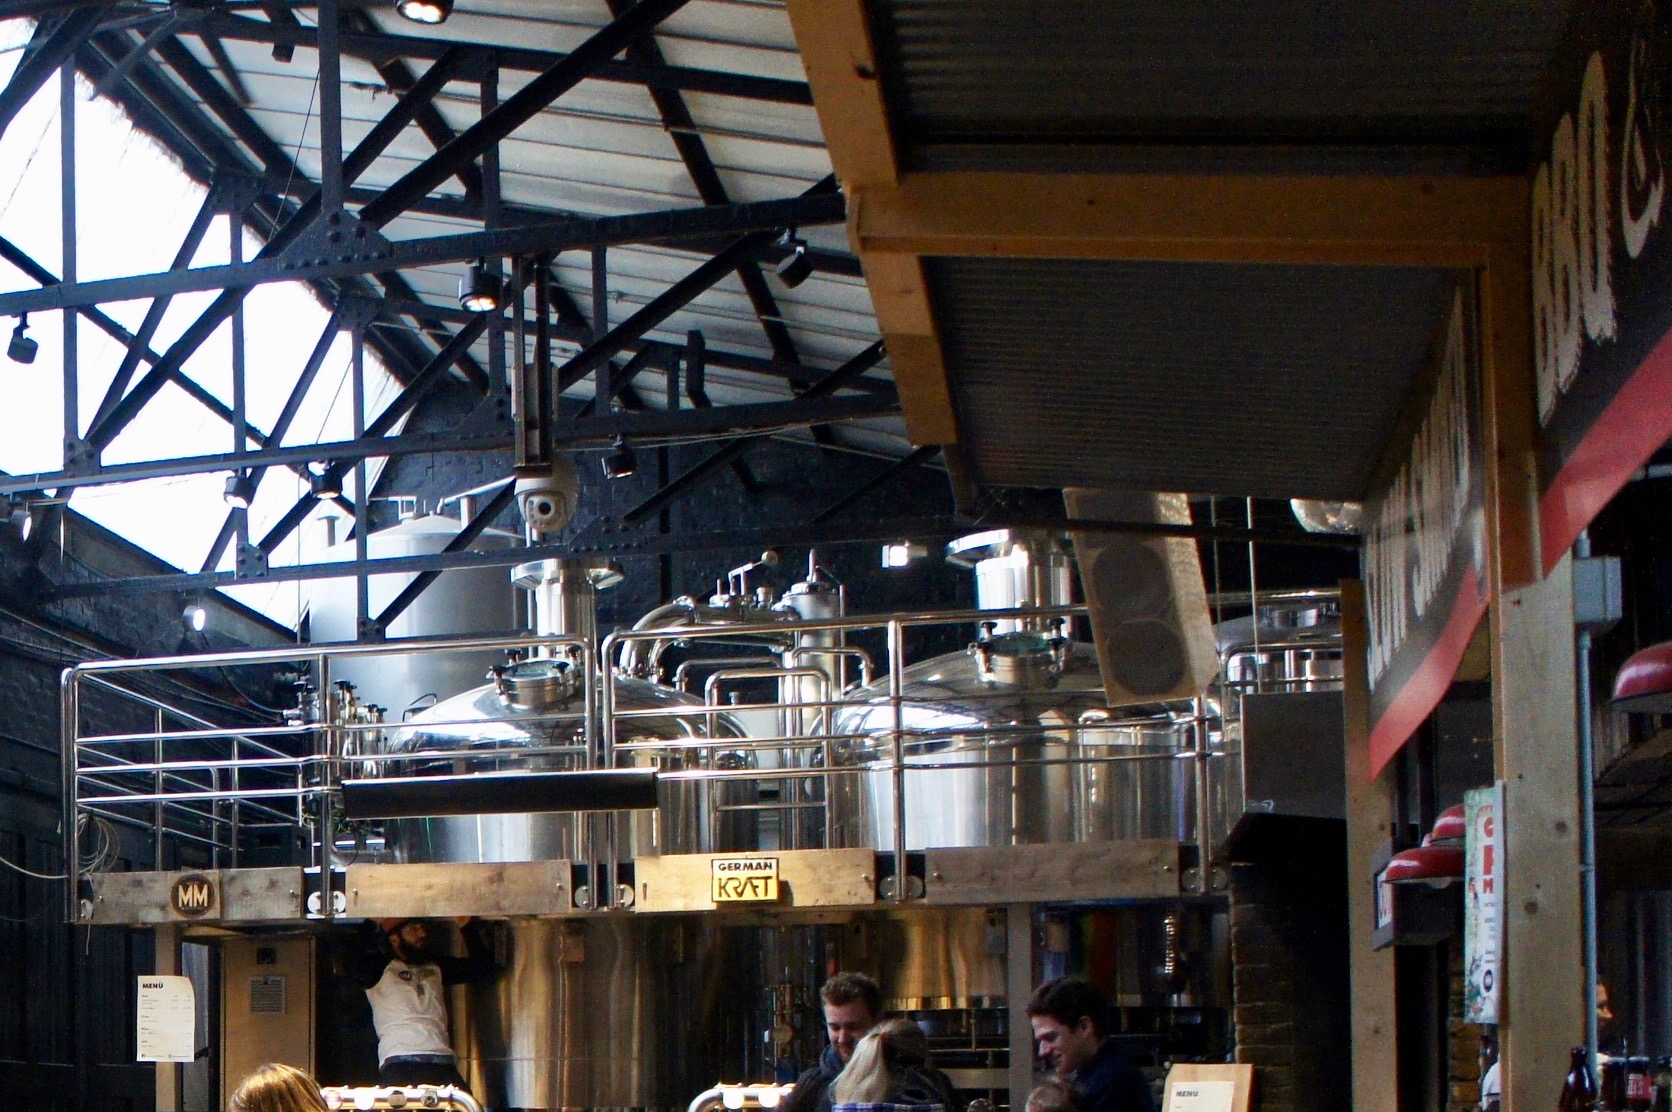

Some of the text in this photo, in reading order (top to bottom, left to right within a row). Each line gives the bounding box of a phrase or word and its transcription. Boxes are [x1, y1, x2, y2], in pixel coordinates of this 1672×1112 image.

[718, 862, 772, 871] GERMAN
[178, 884, 208, 907] MM
[718, 876, 773, 898] KRAFT
